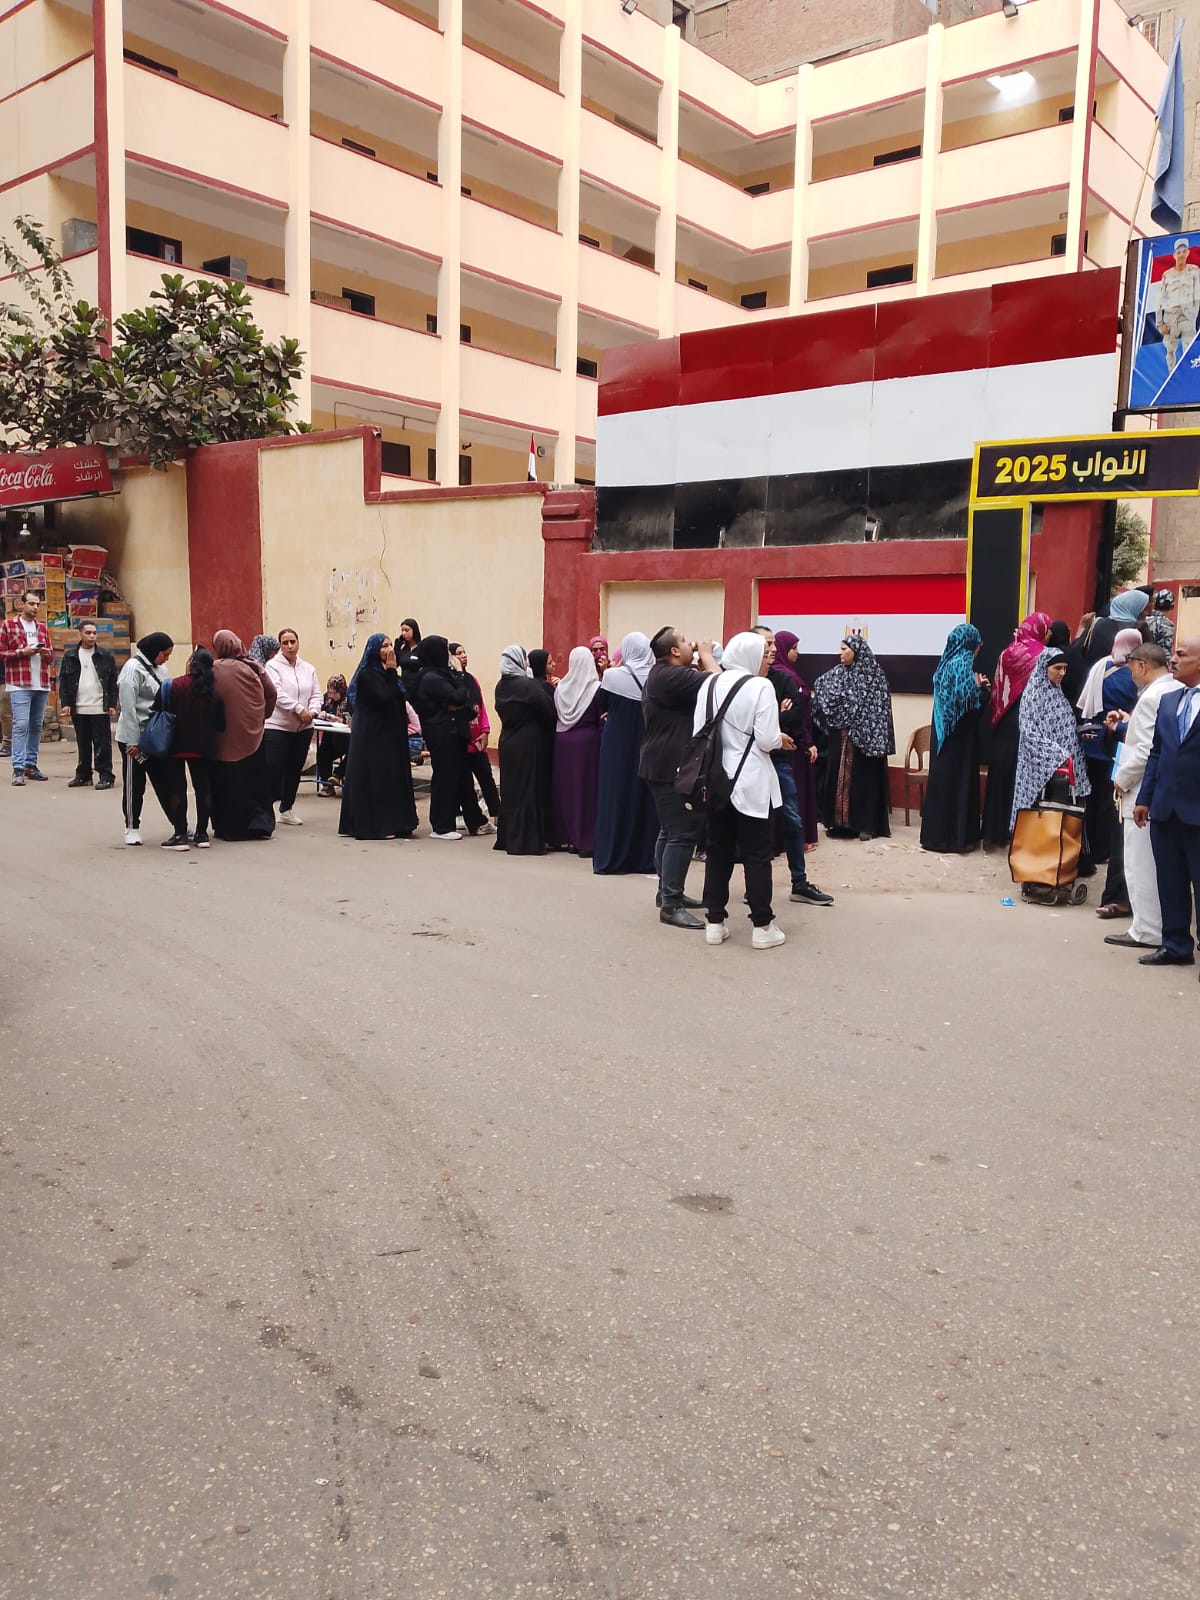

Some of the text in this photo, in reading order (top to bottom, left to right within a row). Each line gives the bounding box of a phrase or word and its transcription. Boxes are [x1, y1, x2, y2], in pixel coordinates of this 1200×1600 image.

[75, 471, 103, 483] الرشاد
[994, 449, 1147, 484] النواب 2025
